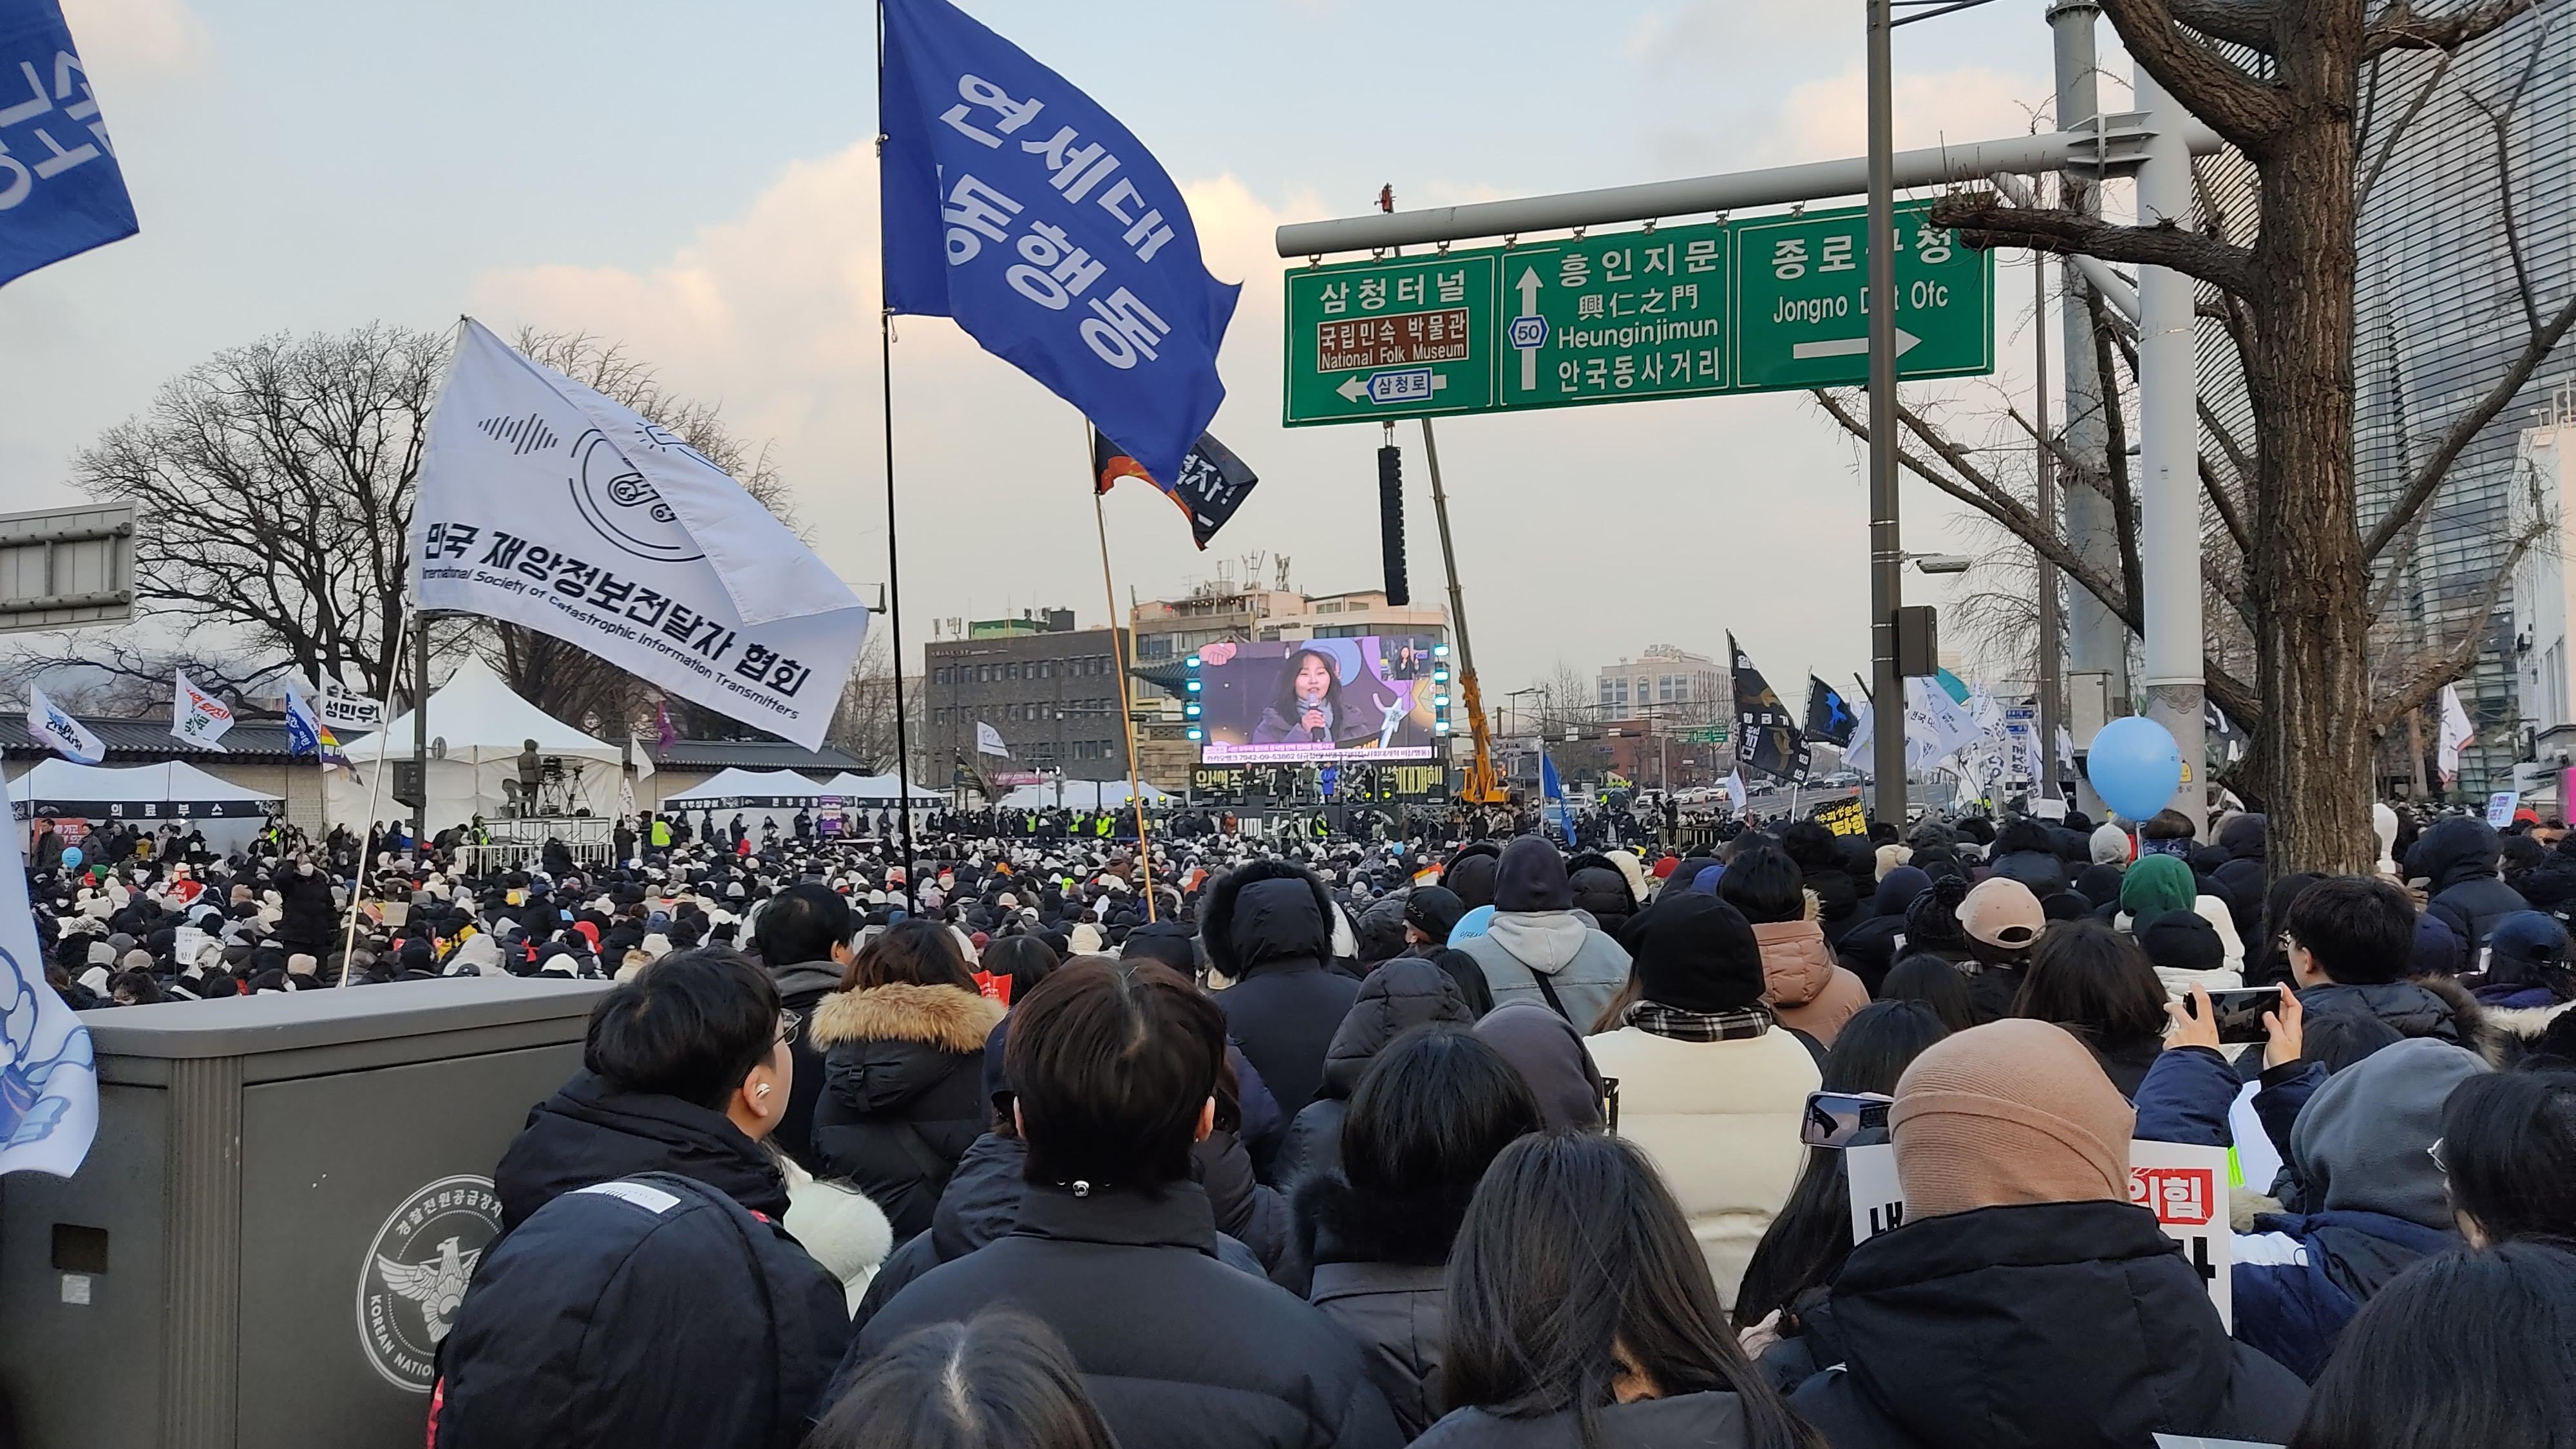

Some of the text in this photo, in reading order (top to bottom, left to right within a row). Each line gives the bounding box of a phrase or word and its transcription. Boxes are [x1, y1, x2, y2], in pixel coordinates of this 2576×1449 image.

[939, 73, 1175, 263] 연세대
[936, 164, 1172, 370] 동행동
[1559, 240, 1719, 287] 흥인지문
[1772, 223, 1953, 279] 종로청
[1320, 270, 1465, 314] 삼청터널
[1578, 283, 1698, 321] 興仁之門
[1774, 295, 1848, 324] Jongno
[1911, 280, 1949, 310] Ofc
[1321, 312, 1465, 351] 국립민속 박물관
[1517, 324, 1540, 341] 50
[1558, 318, 1718, 349] Heunginjimun
[1321, 343, 1465, 370] National Folk Museum
[1558, 347, 1719, 392] 안국동사거리
[1378, 375, 1426, 395] 삼청로
[478, 531, 737, 661] 재앙정보전달자
[735, 642, 812, 698] 협회
[473, 571, 529, 594] Society
[529, 587, 547, 598] of
[549, 593, 635, 641] Catastrophic
[638, 632, 713, 677] Information
[716, 670, 800, 720] Transmitters
[370, 1294, 435, 1378] KOREAN NATIO
